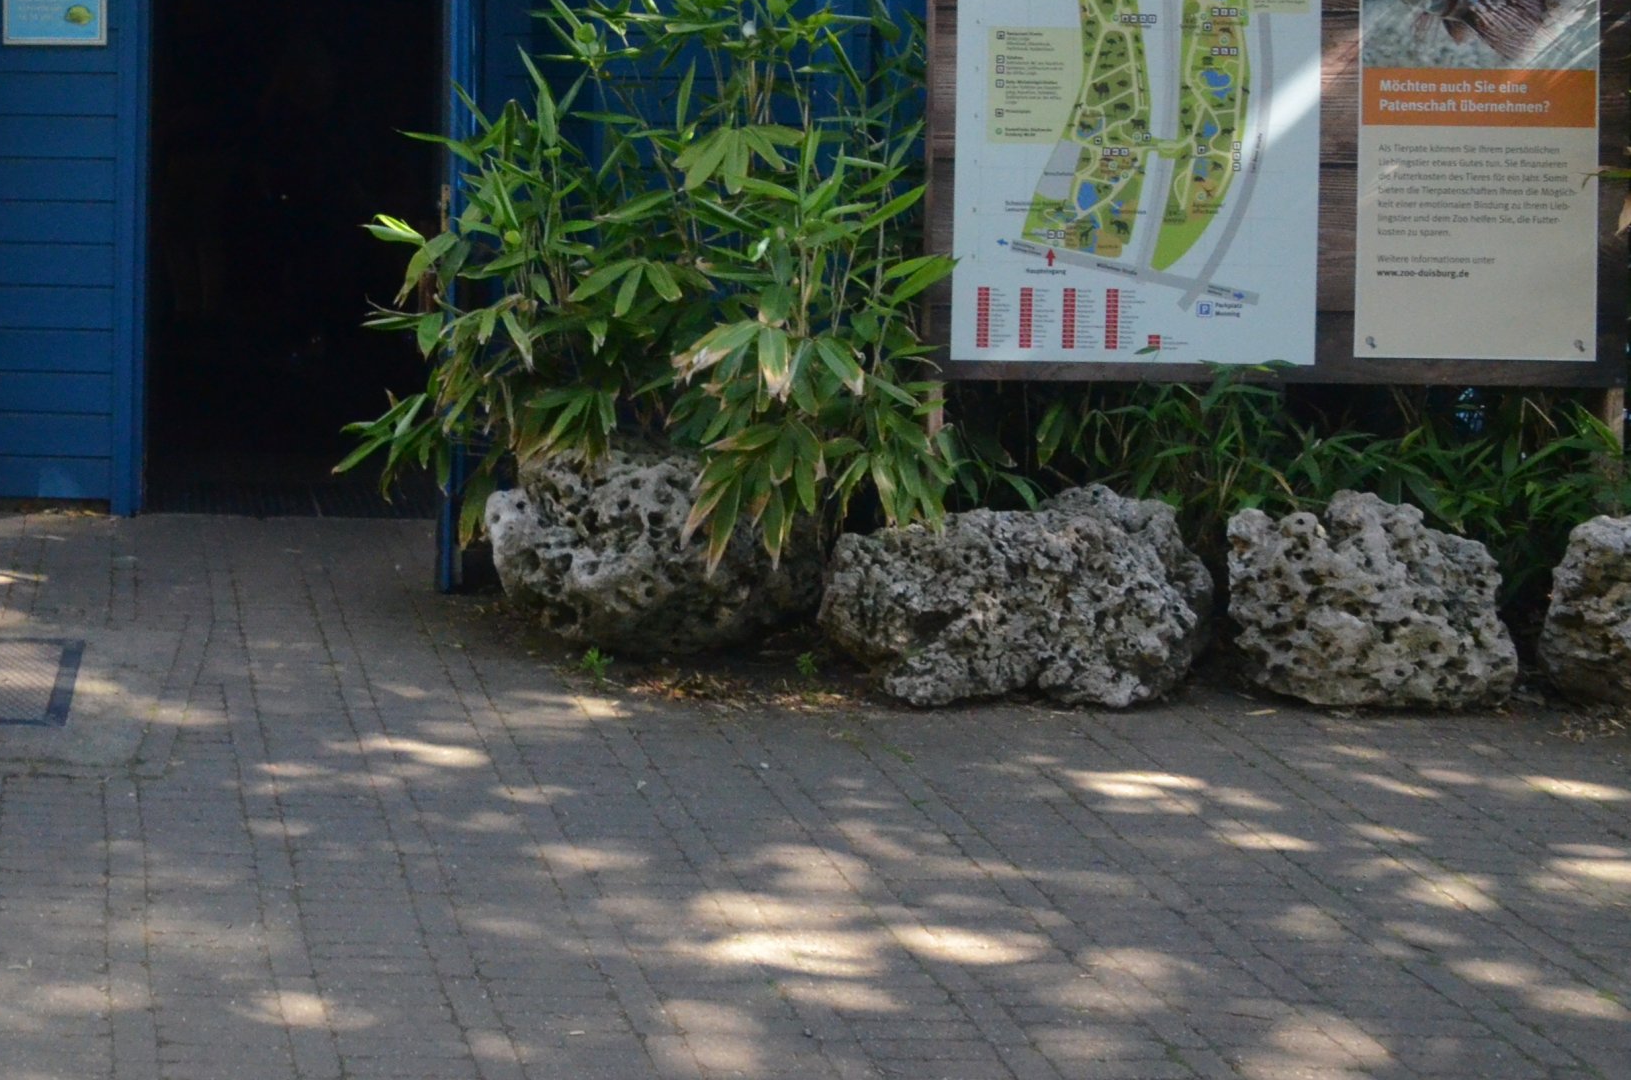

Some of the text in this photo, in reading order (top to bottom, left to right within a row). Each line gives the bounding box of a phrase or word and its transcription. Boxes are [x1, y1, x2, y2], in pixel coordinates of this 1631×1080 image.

[1380, 80, 1527, 93] Möchten auch Sie eine
[1380, 99, 1550, 113] Patenschaft übernehmen?
[1379, 144, 1391, 153] Als
[1394, 144, 1428, 154] Tierpate
[1430, 145, 1461, 153] können
[1463, 145, 1476, 153] Sie
[1505, 145, 1560, 154] persönlichen
[1379, 158, 1429, 168] Lieblingstier
[1520, 160, 1568, 168] finanzieren
[1394, 172, 1446, 181] Futterkosten
[1449, 173, 1463, 181] des
[1466, 173, 1490, 181] Tieres
[1493, 174, 1505, 182] für
[1543, 174, 1568, 182] Somit
[1379, 187, 1405, 195] bieten
[1422, 187, 1498, 196] Tierpatenschaften
[1378, 200, 1394, 208] keit
[1474, 201, 1509, 210] Bindung
[1550, 202, 1570, 210] Lieb-
[1378, 214, 1412, 223] lingstier
[1453, 215, 1468, 223] Zoo
[1471, 215, 1496, 223] helfen
[1499, 216, 1515, 224] Sie,
[1533, 216, 1560, 224] Futter-
[1420, 229, 1450, 238] sparen.
[1377, 270, 1469, 279] www.zoo-duisburg.de
